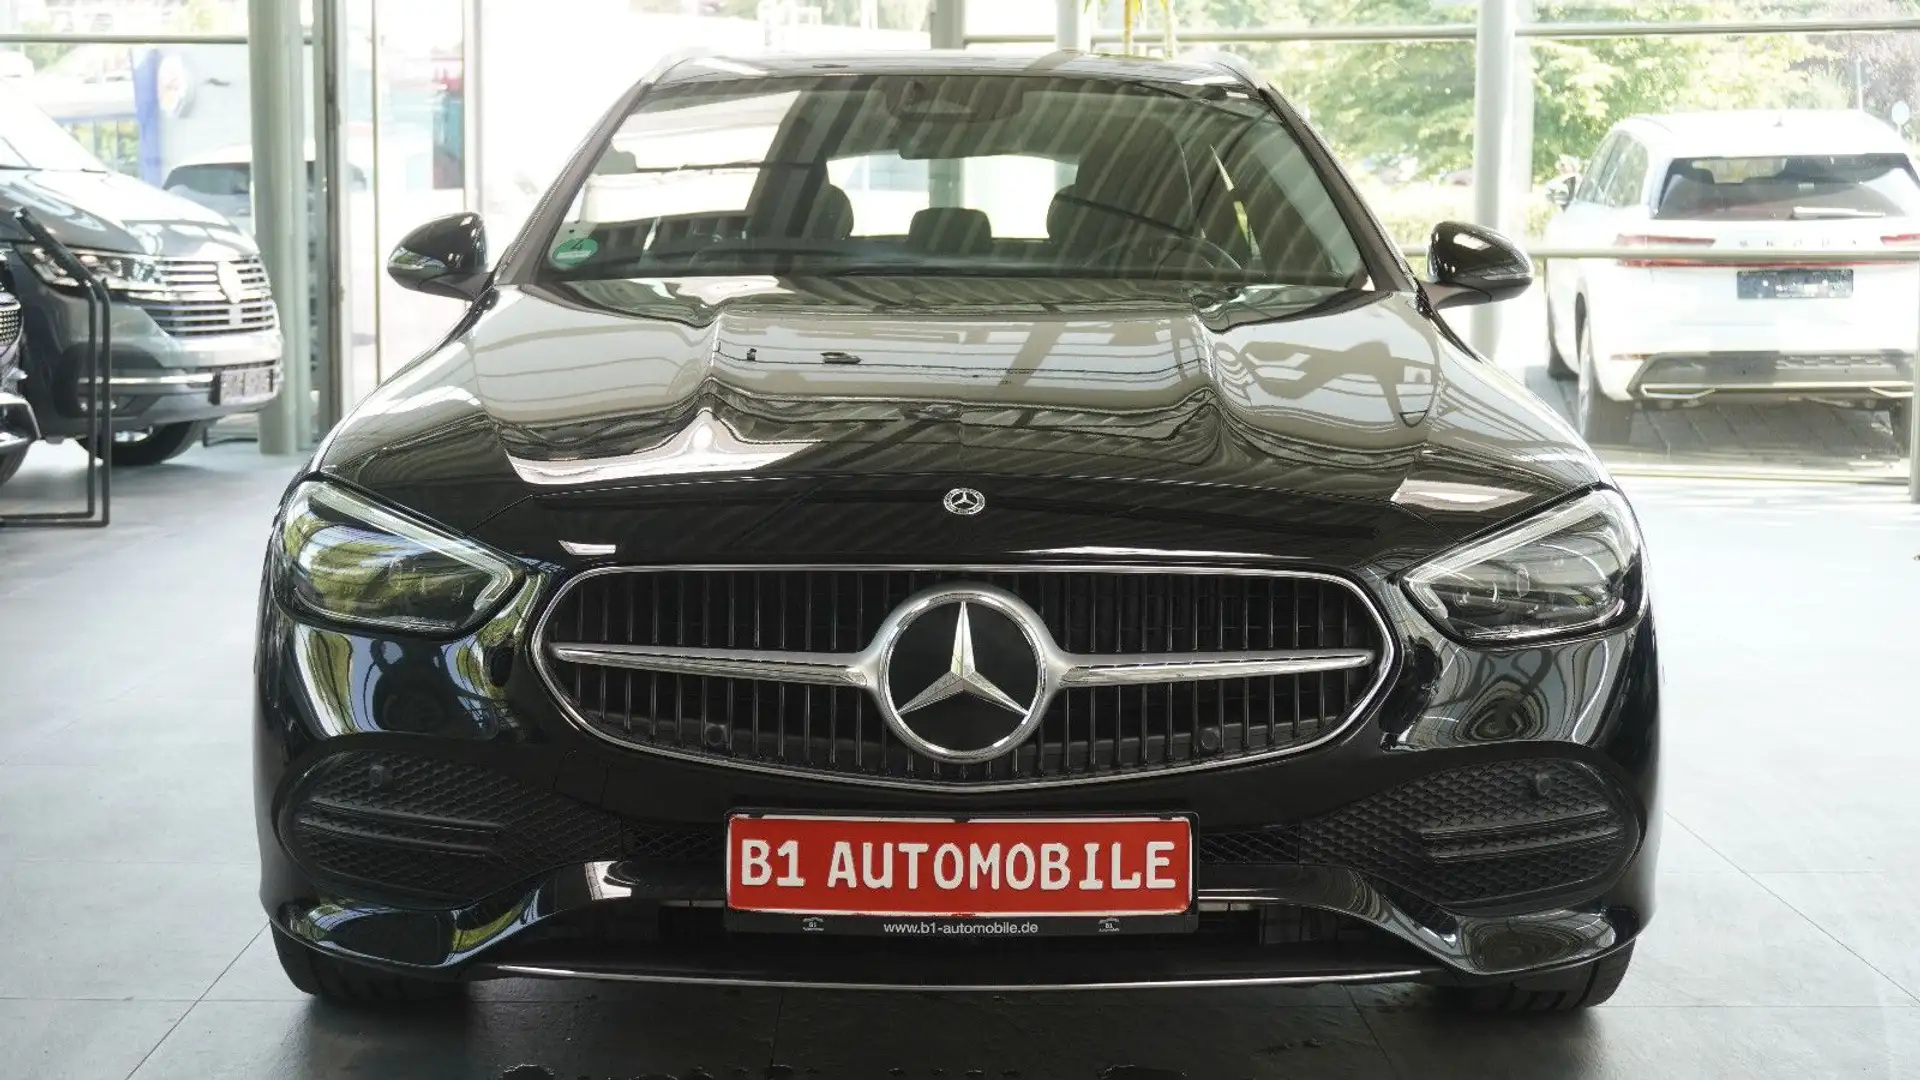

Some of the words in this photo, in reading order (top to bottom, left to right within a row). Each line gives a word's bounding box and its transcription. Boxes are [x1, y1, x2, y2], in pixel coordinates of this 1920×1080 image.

[742, 838, 805, 887] B1
[827, 841, 1176, 890] AUTOMOBILE
[883, 921, 1039, 935] www.b1-automobile.de
